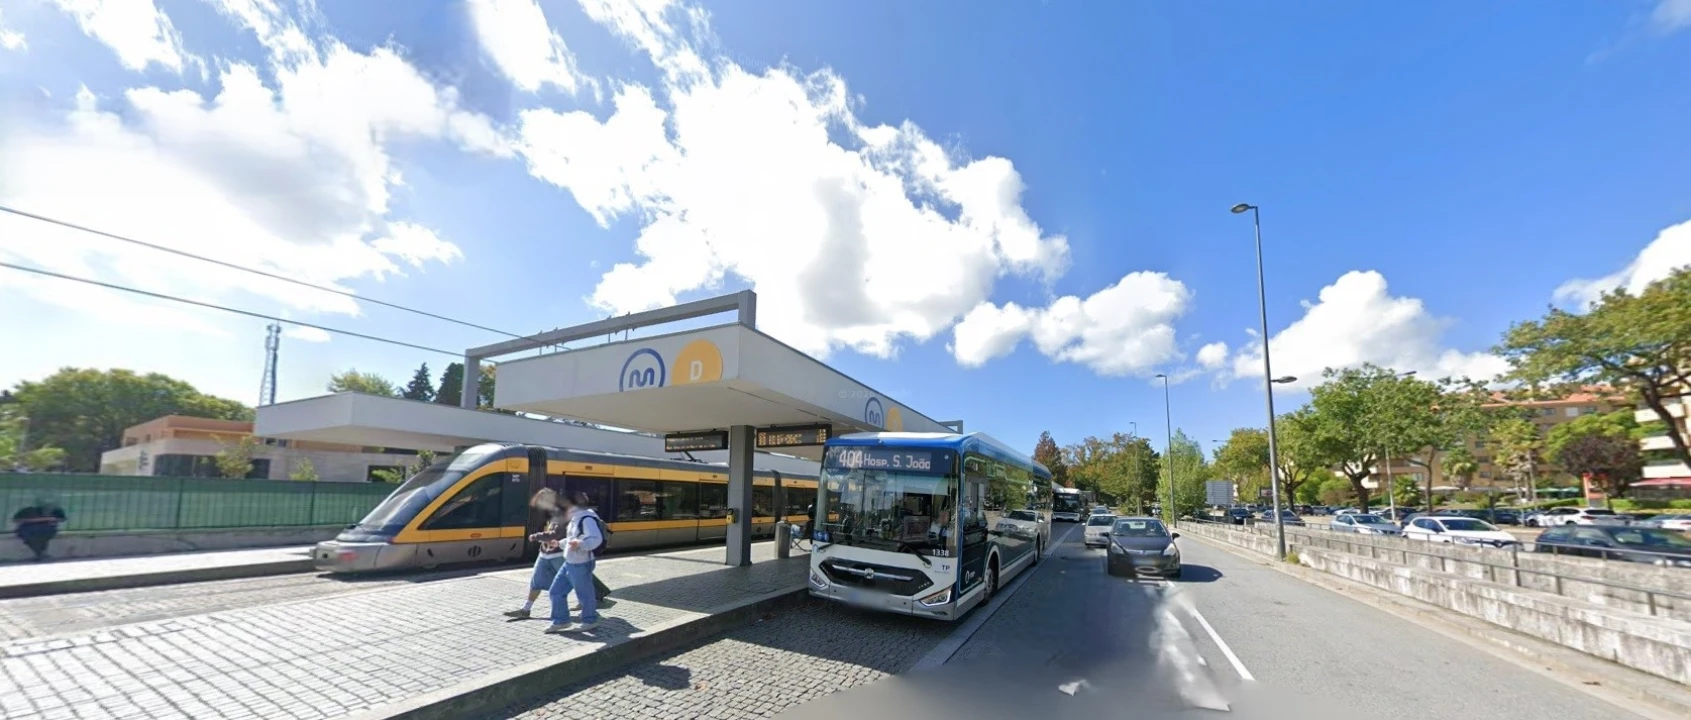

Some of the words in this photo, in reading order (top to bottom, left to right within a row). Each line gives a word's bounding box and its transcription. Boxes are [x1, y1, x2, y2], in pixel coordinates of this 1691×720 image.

[690, 360, 702, 381] D
[839, 449, 863, 468] 404
[864, 453, 890, 469] Hosp.
[892, 455, 902, 468] S.
[932, 549, 950, 557] 1338
